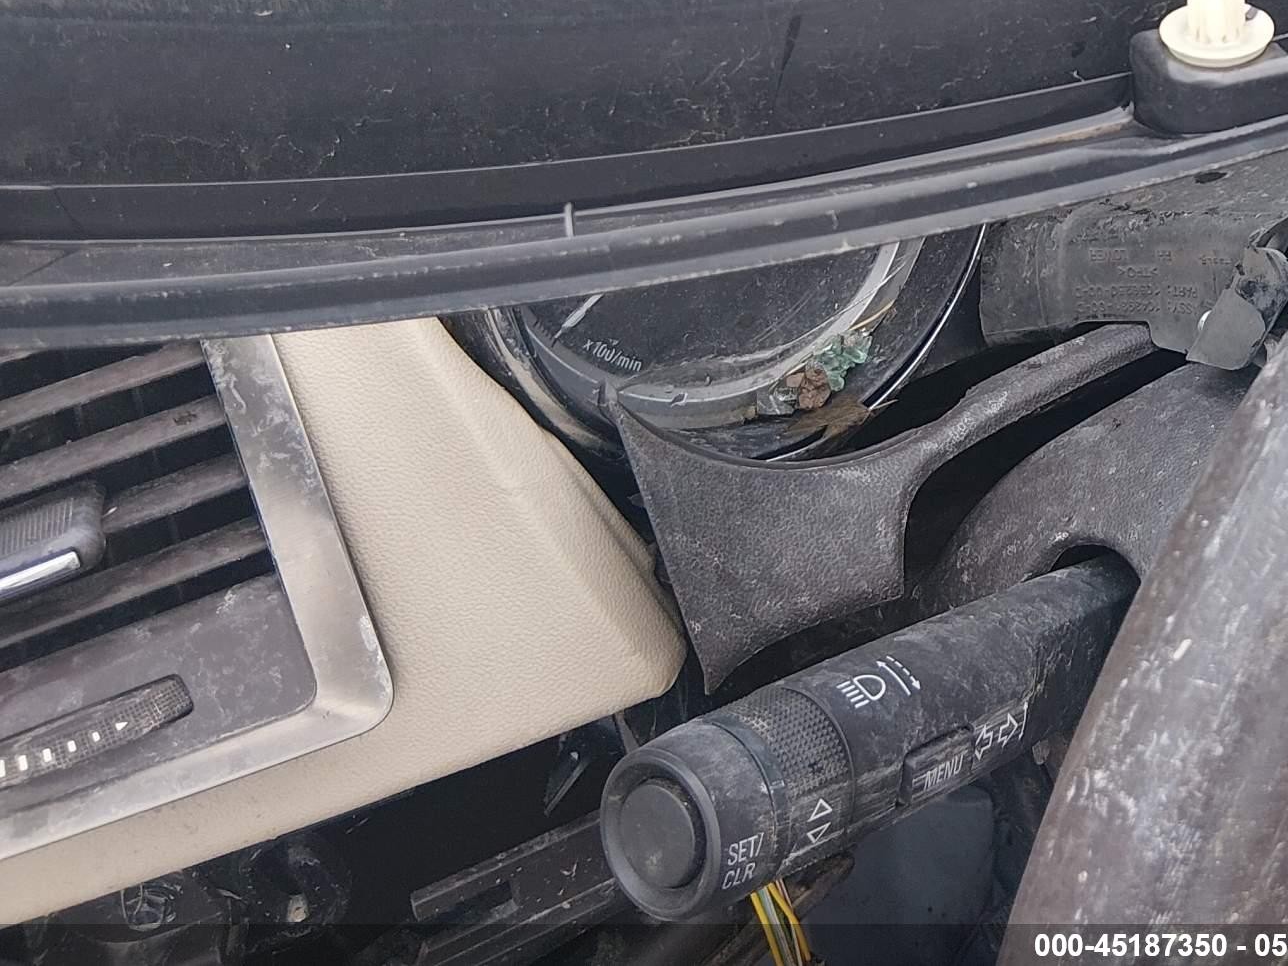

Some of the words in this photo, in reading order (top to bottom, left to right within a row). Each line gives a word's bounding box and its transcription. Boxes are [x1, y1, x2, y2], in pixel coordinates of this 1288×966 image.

[923, 754, 965, 791] MENU
[727, 832, 765, 867] SET/
[721, 862, 757, 891] CLR
